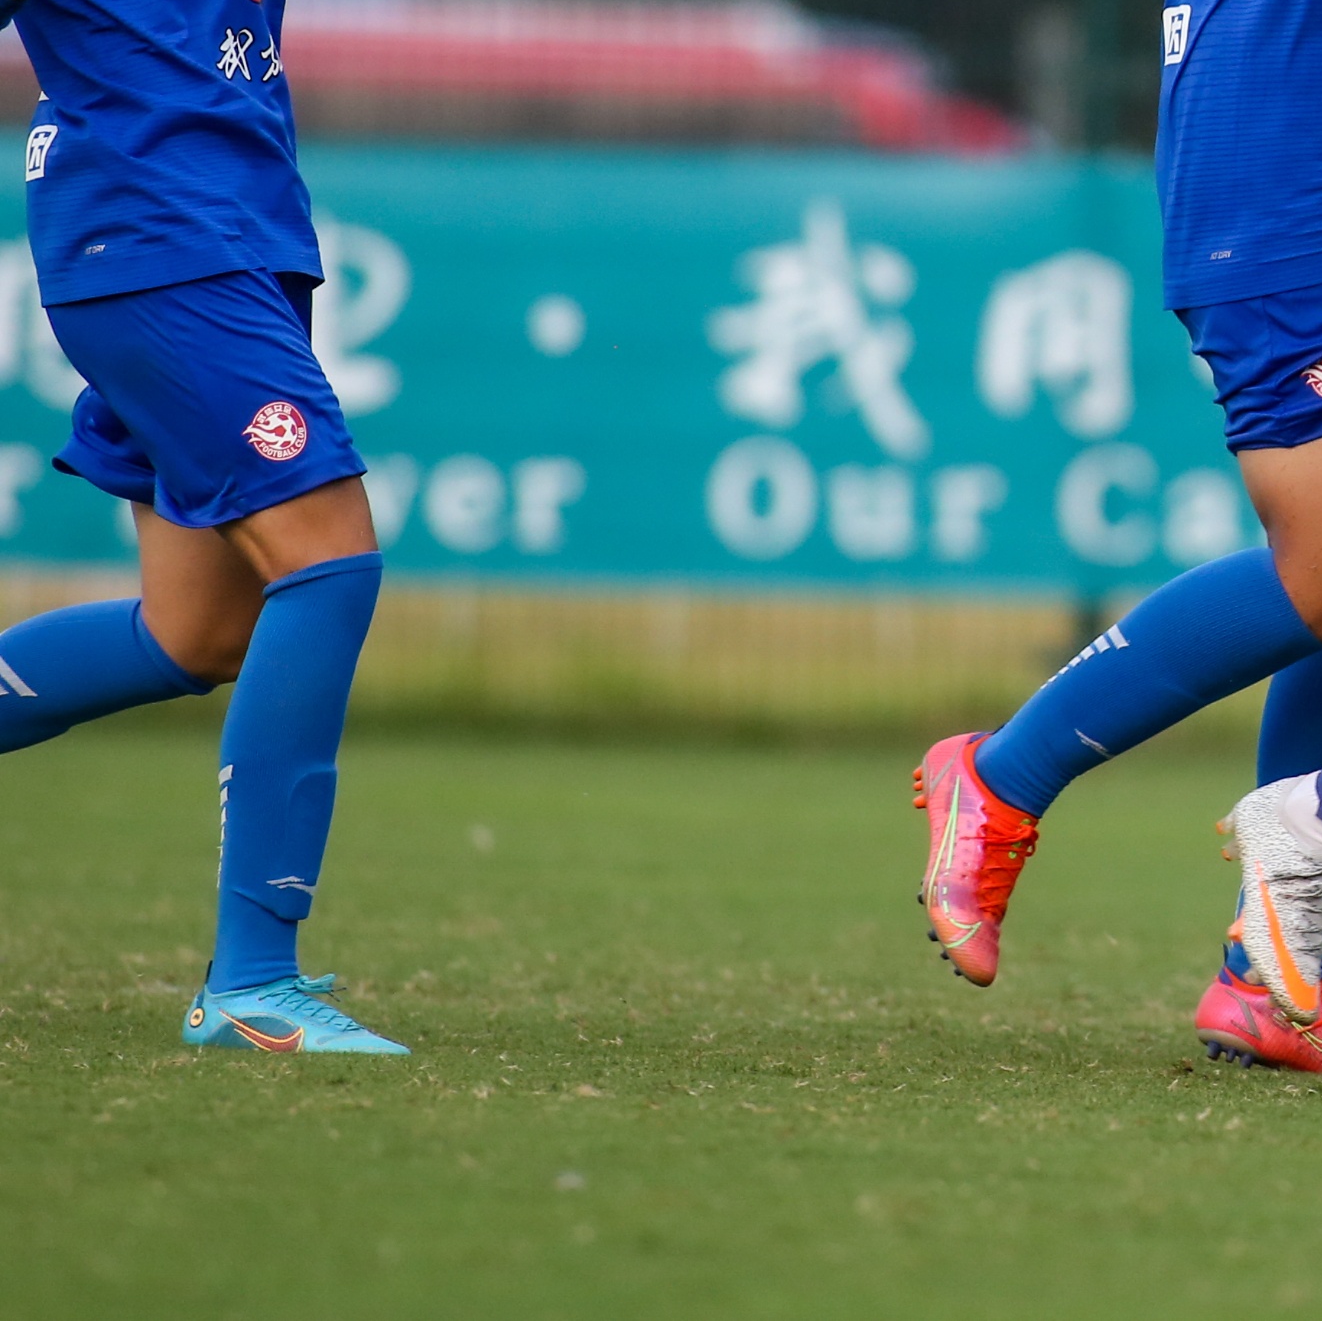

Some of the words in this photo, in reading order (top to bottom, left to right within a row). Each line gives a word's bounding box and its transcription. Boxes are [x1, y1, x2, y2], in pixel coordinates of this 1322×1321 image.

[259, 441, 298, 458] FOOTBALL
[703, 434, 1008, 562] Our
[1055, 441, 1250, 568] Ca
